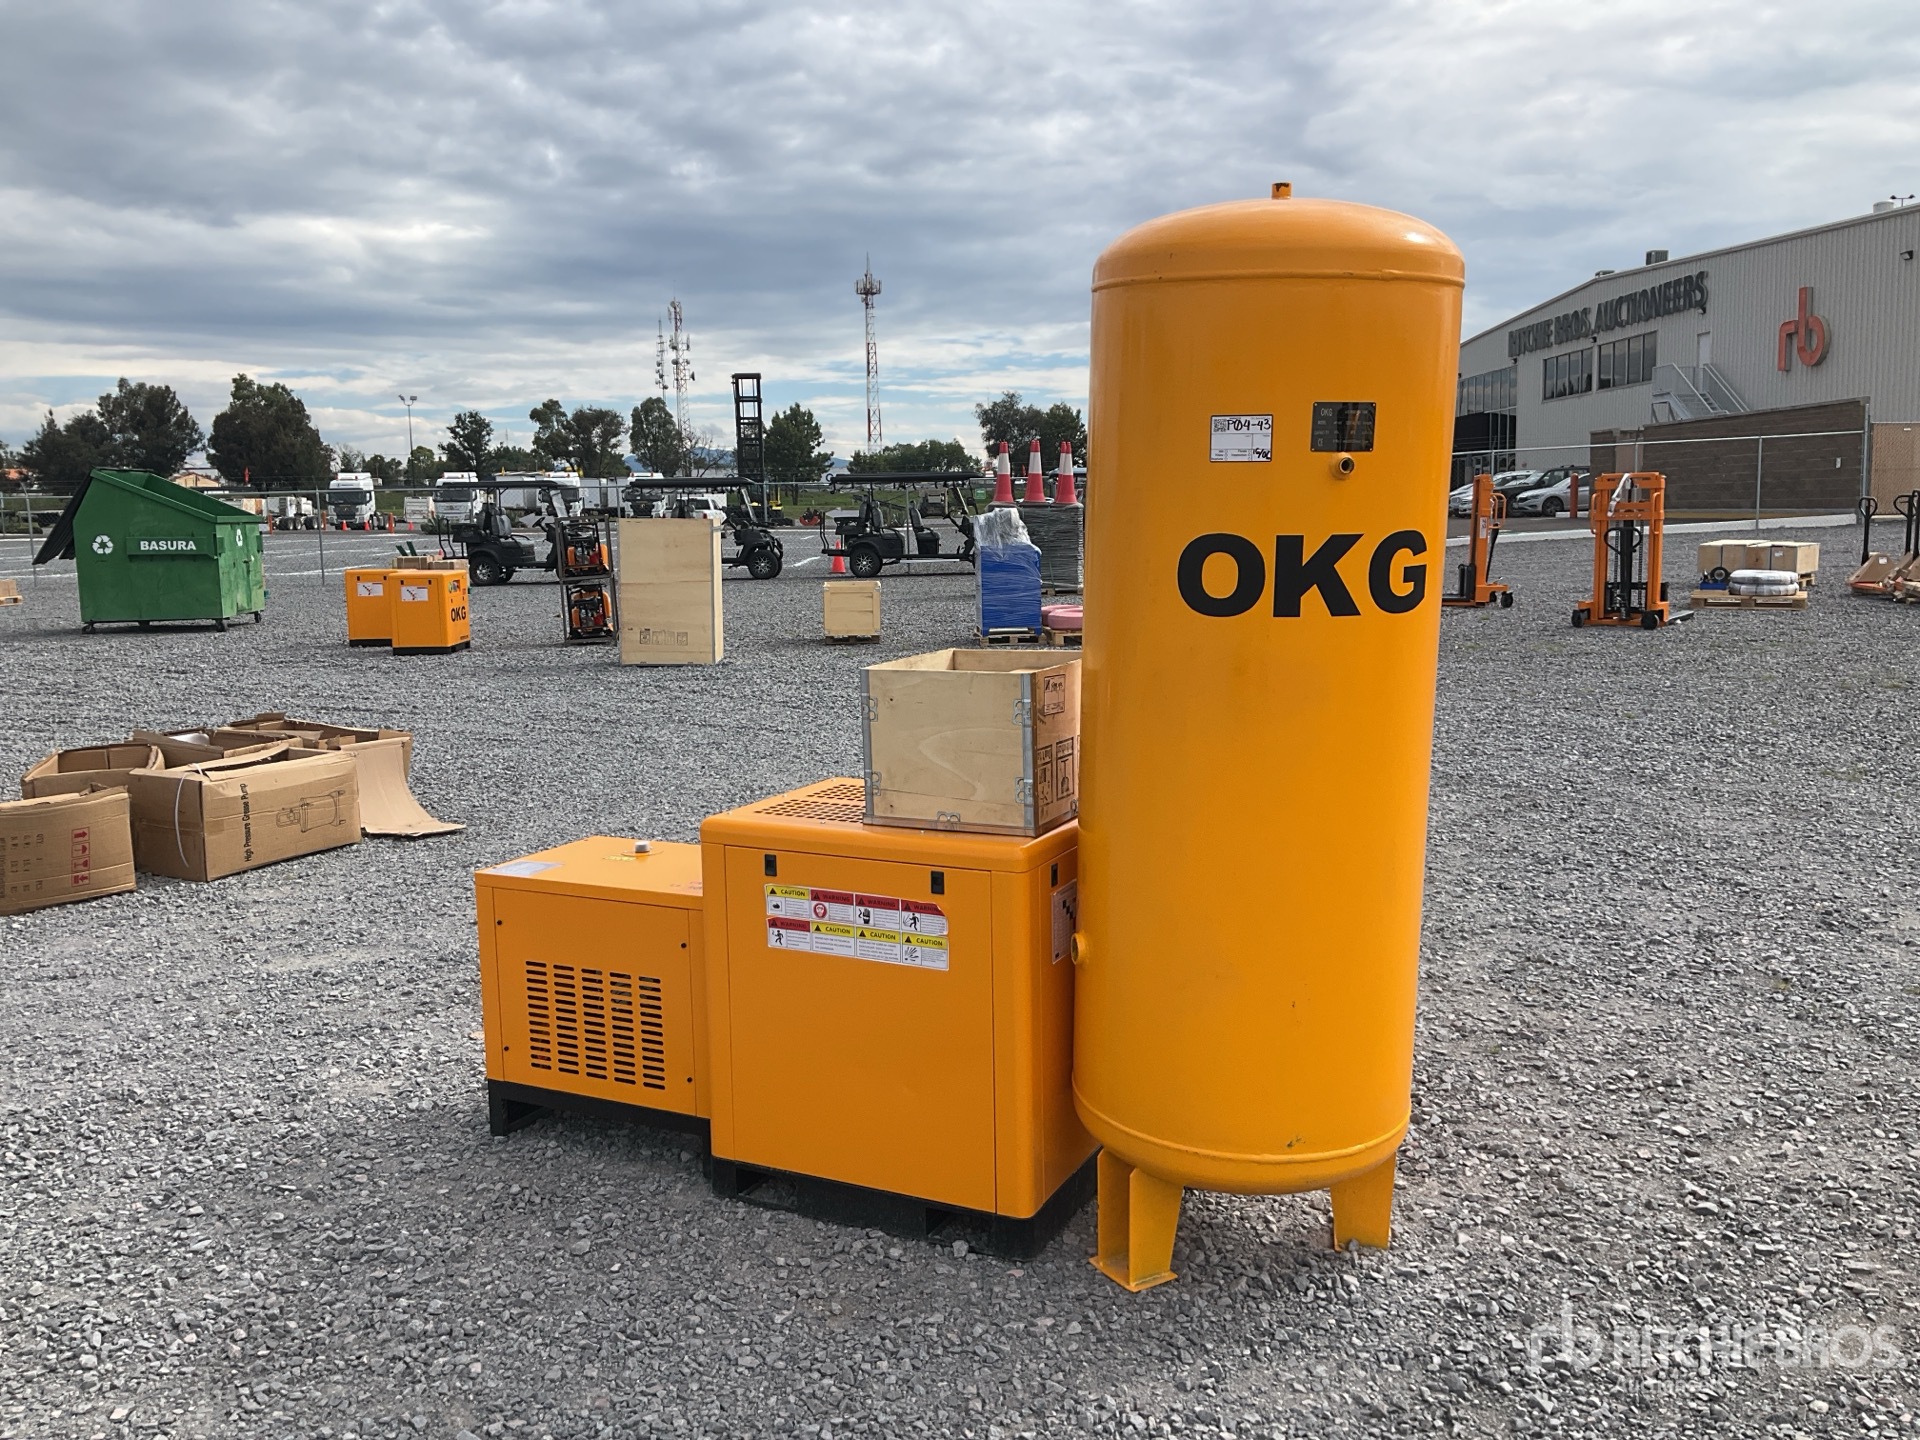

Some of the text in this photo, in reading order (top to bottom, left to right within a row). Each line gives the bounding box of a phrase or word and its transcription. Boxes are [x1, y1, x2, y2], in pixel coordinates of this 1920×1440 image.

[140, 540, 197, 551] BASURA
[1177, 529, 1428, 618] OKG
[450, 605, 466, 622] OKG
[239, 783, 254, 862] High Pressure Grease Pump
[781, 888, 805, 897] CAUTION
[825, 926, 851, 934] CAUTION
[870, 931, 896, 940] CAUTION
[916, 937, 943, 946] CAUTION
